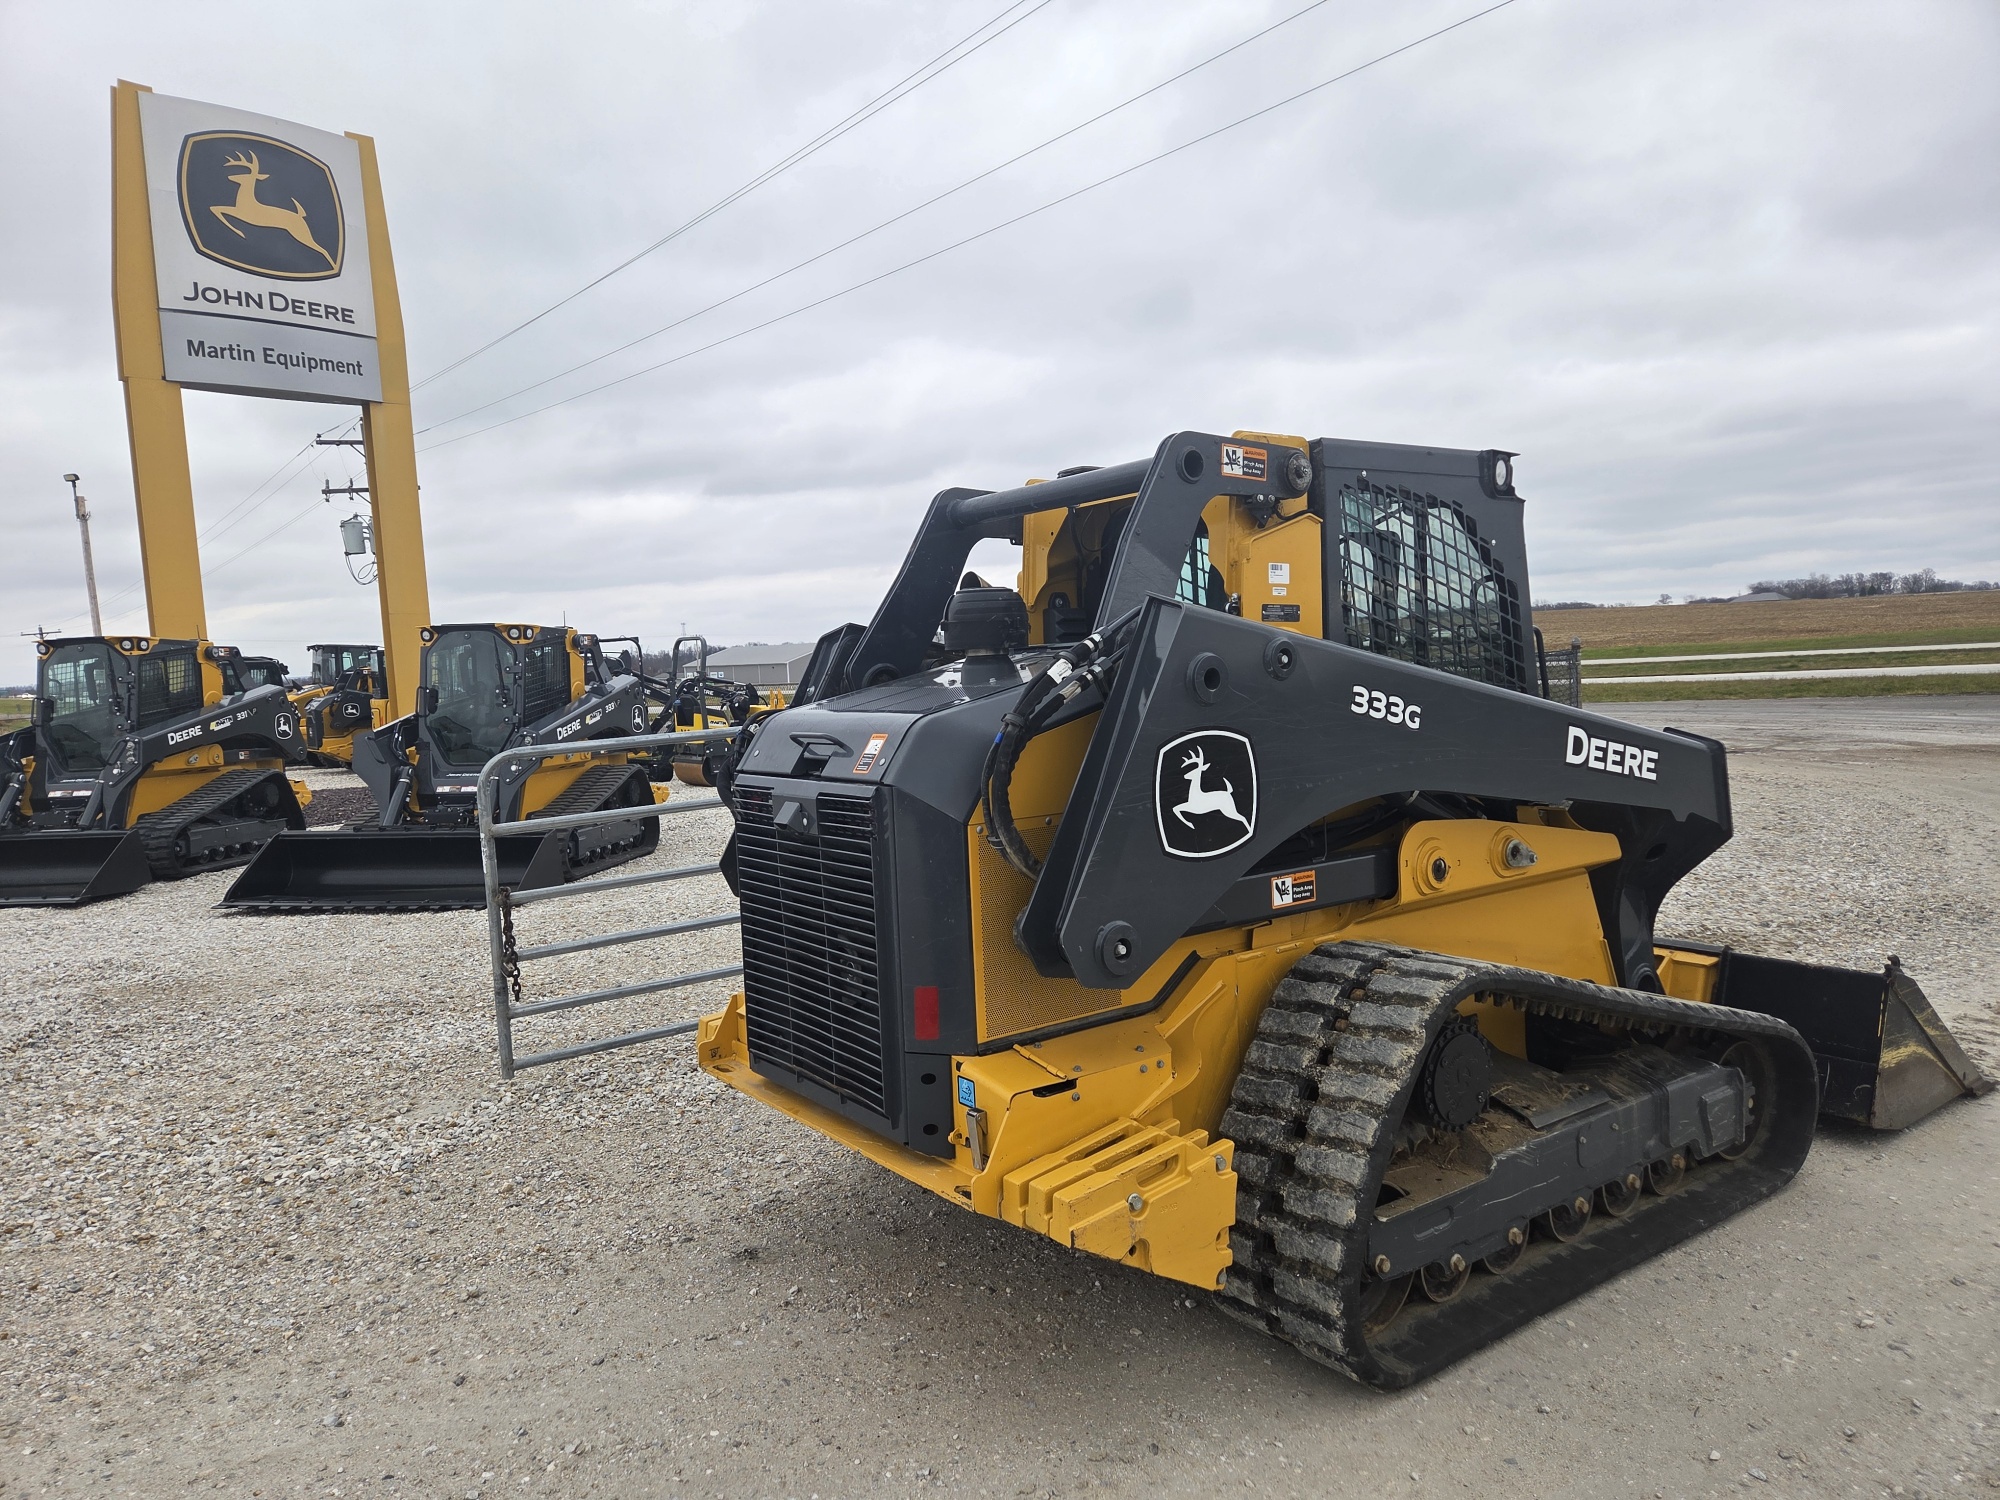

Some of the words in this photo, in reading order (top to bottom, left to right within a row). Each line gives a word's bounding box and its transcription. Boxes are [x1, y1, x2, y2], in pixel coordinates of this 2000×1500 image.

[183, 281, 263, 310] JOHN
[269, 290, 355, 324] DEERE
[186, 339, 255, 363] Martin
[262, 347, 363, 376] Equipment
[168, 725, 202, 746] DEERE
[557, 718, 582, 740] DEERE
[1350, 685, 1422, 730] 333G
[1565, 725, 1660, 781] DEERE
